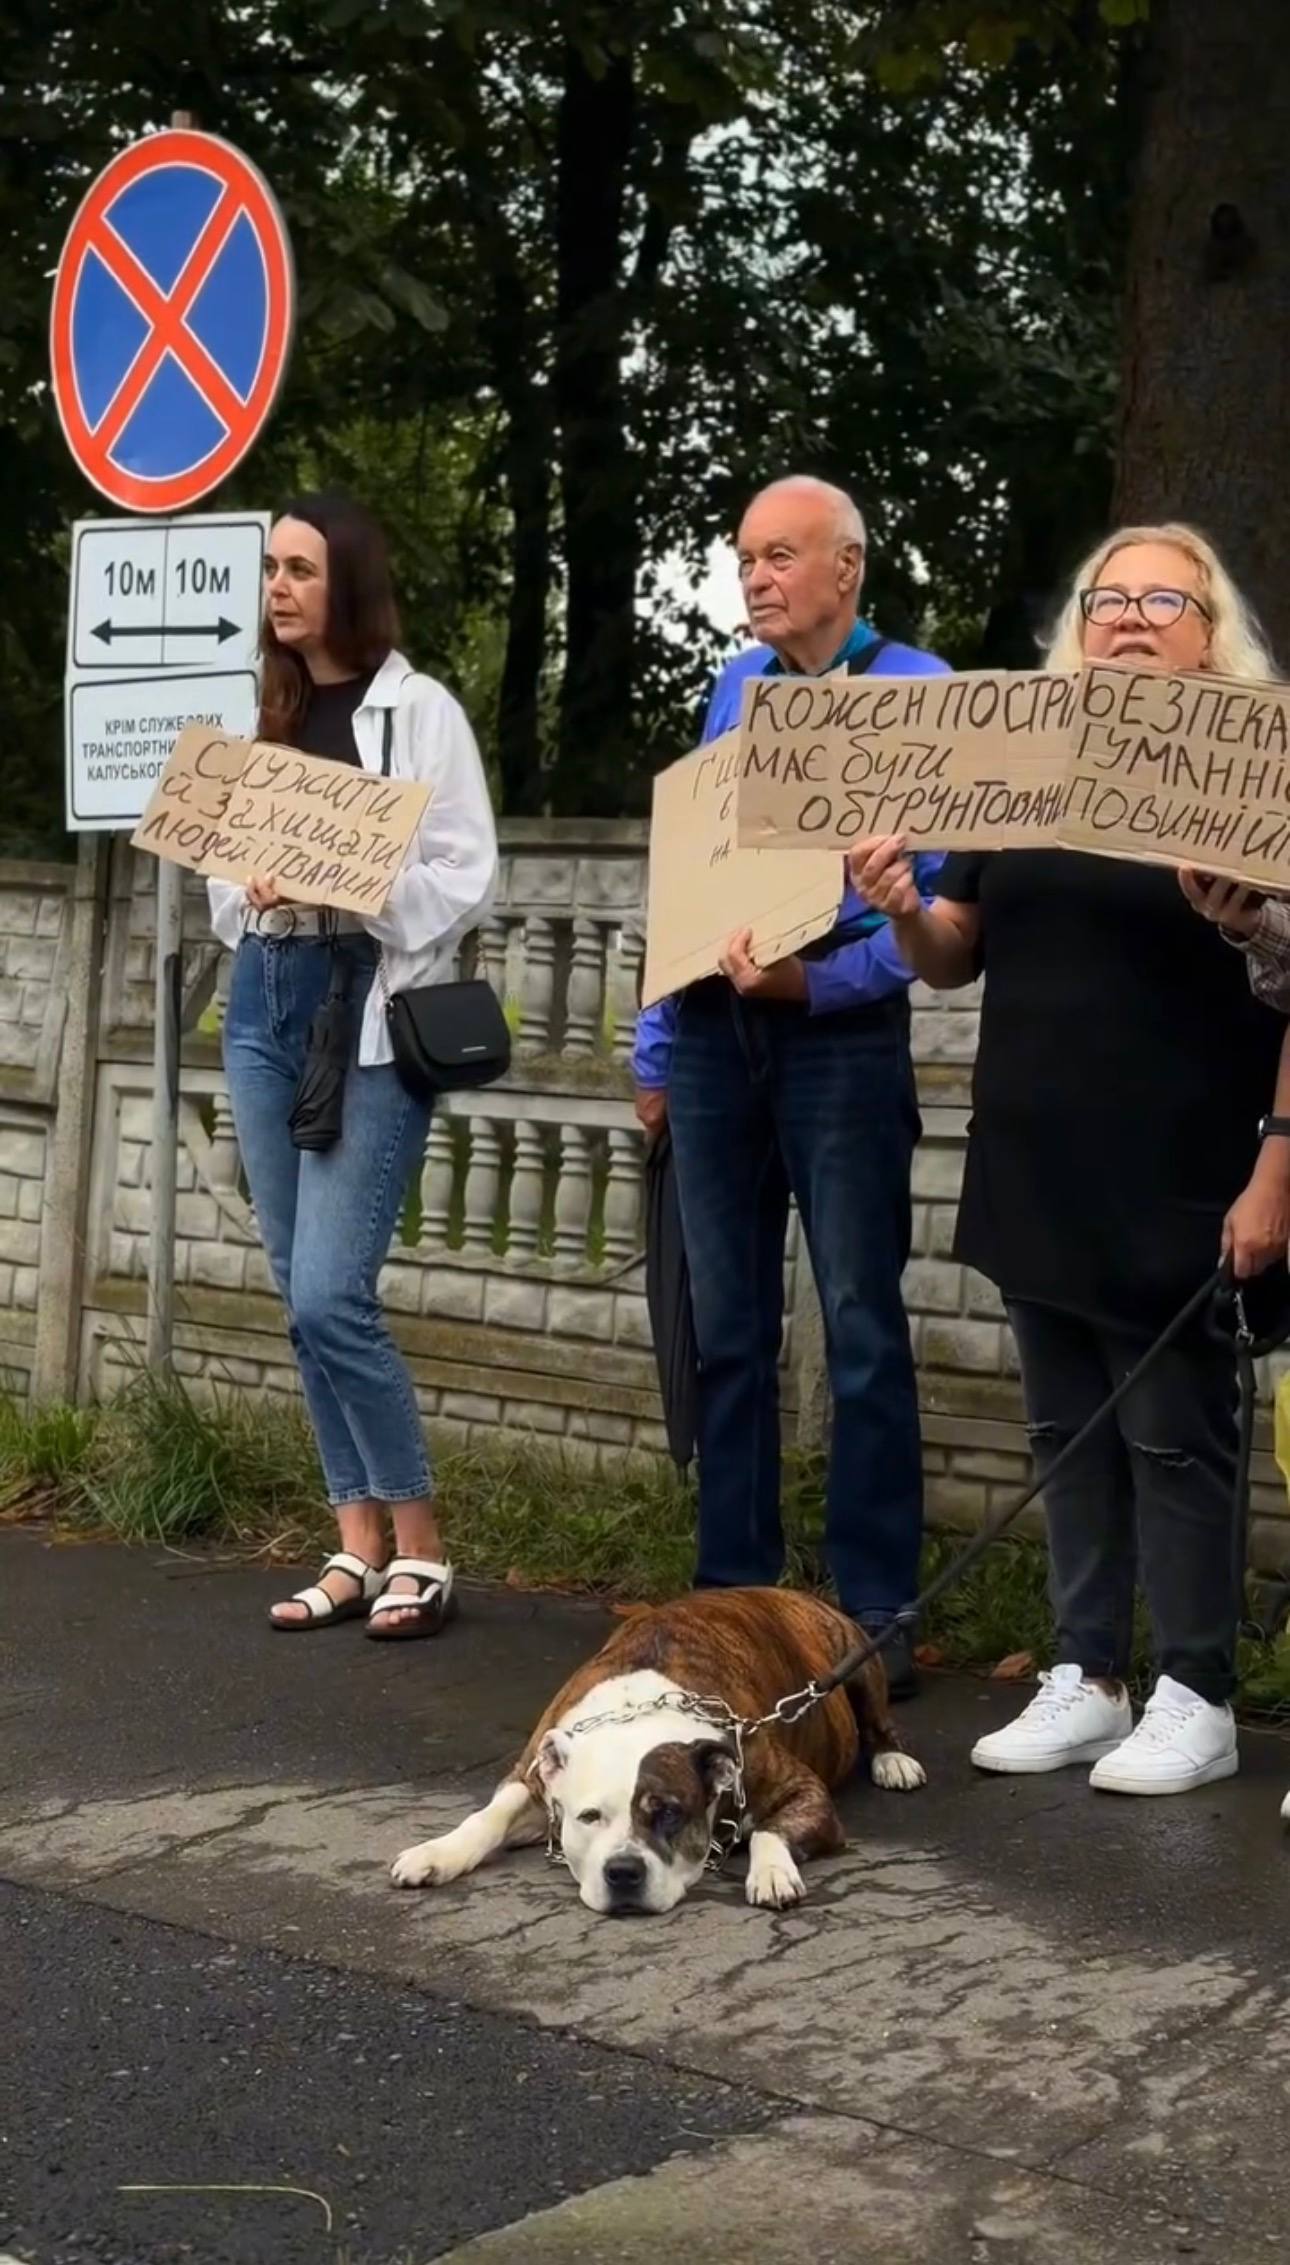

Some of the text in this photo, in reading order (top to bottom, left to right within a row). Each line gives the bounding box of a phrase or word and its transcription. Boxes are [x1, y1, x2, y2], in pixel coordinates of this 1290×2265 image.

[104, 558, 230, 596] 10м 10м
[105, 718, 135, 736] КРІМ
[1083, 667, 1288, 754] БЕЗПЕКА
[82, 739, 177, 759] ТРАНСПОРТНИ
[743, 743, 829, 785] МАЄ
[88, 761, 164, 781] КАЛУСЬКОГ
[1063, 775, 1248, 852] ПОВИННІ
